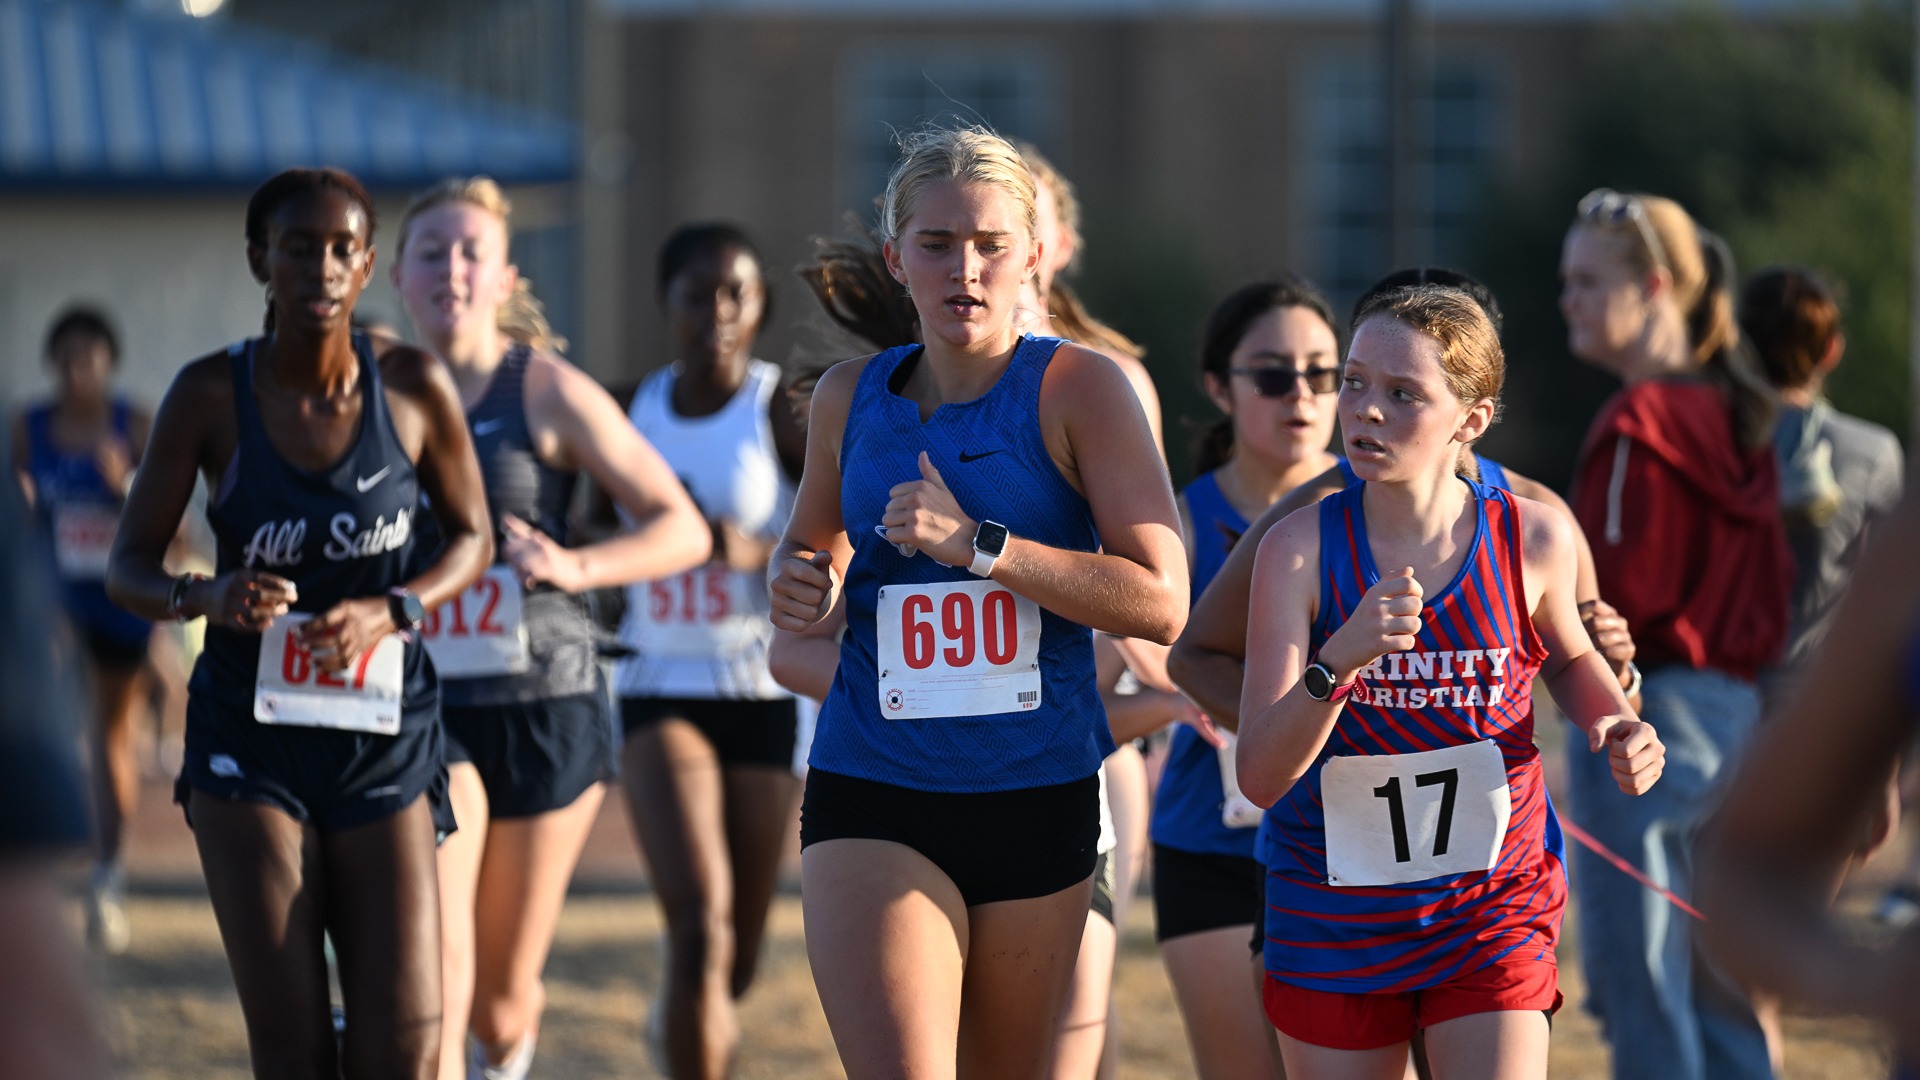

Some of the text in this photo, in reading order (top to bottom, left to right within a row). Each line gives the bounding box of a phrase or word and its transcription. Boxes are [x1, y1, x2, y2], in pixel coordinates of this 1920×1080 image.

[243, 516, 306, 567] All
[901, 590, 1018, 669] 690
[1359, 647, 1511, 681] RINITY
[1351, 683, 1505, 709] RISTIAN
[1373, 768, 1459, 863] 17
